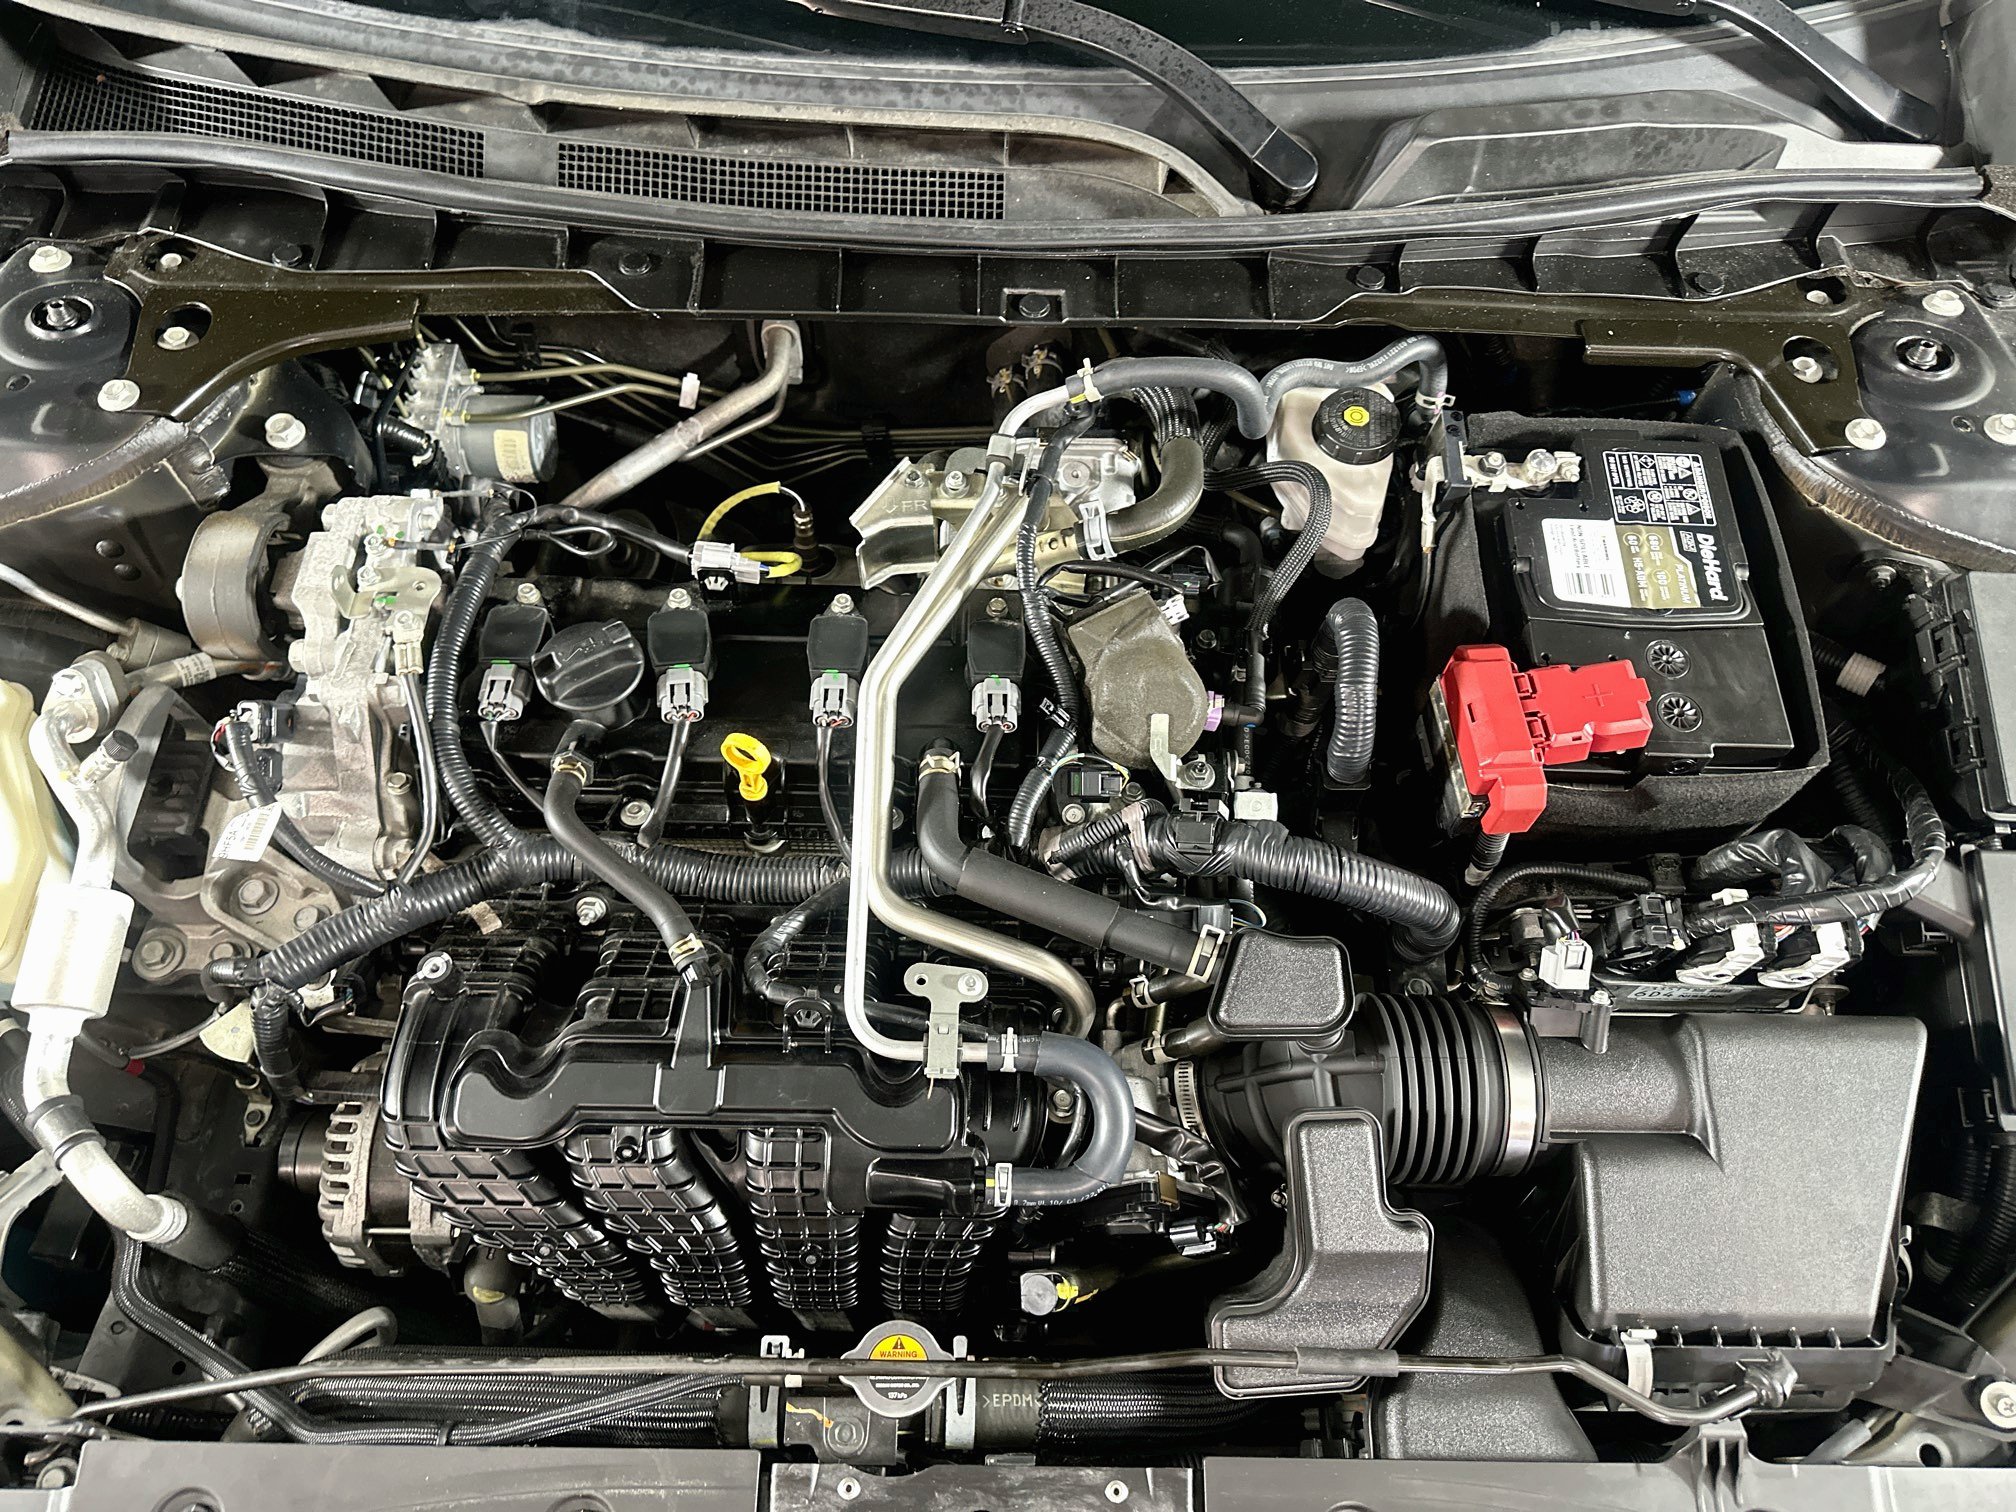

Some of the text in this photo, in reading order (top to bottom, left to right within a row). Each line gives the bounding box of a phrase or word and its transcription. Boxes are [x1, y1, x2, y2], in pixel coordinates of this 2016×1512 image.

[1675, 563, 1692, 604] PLATINUM
[1696, 533, 1729, 602] DieHard
[879, 1350, 918, 1358] WARNING
